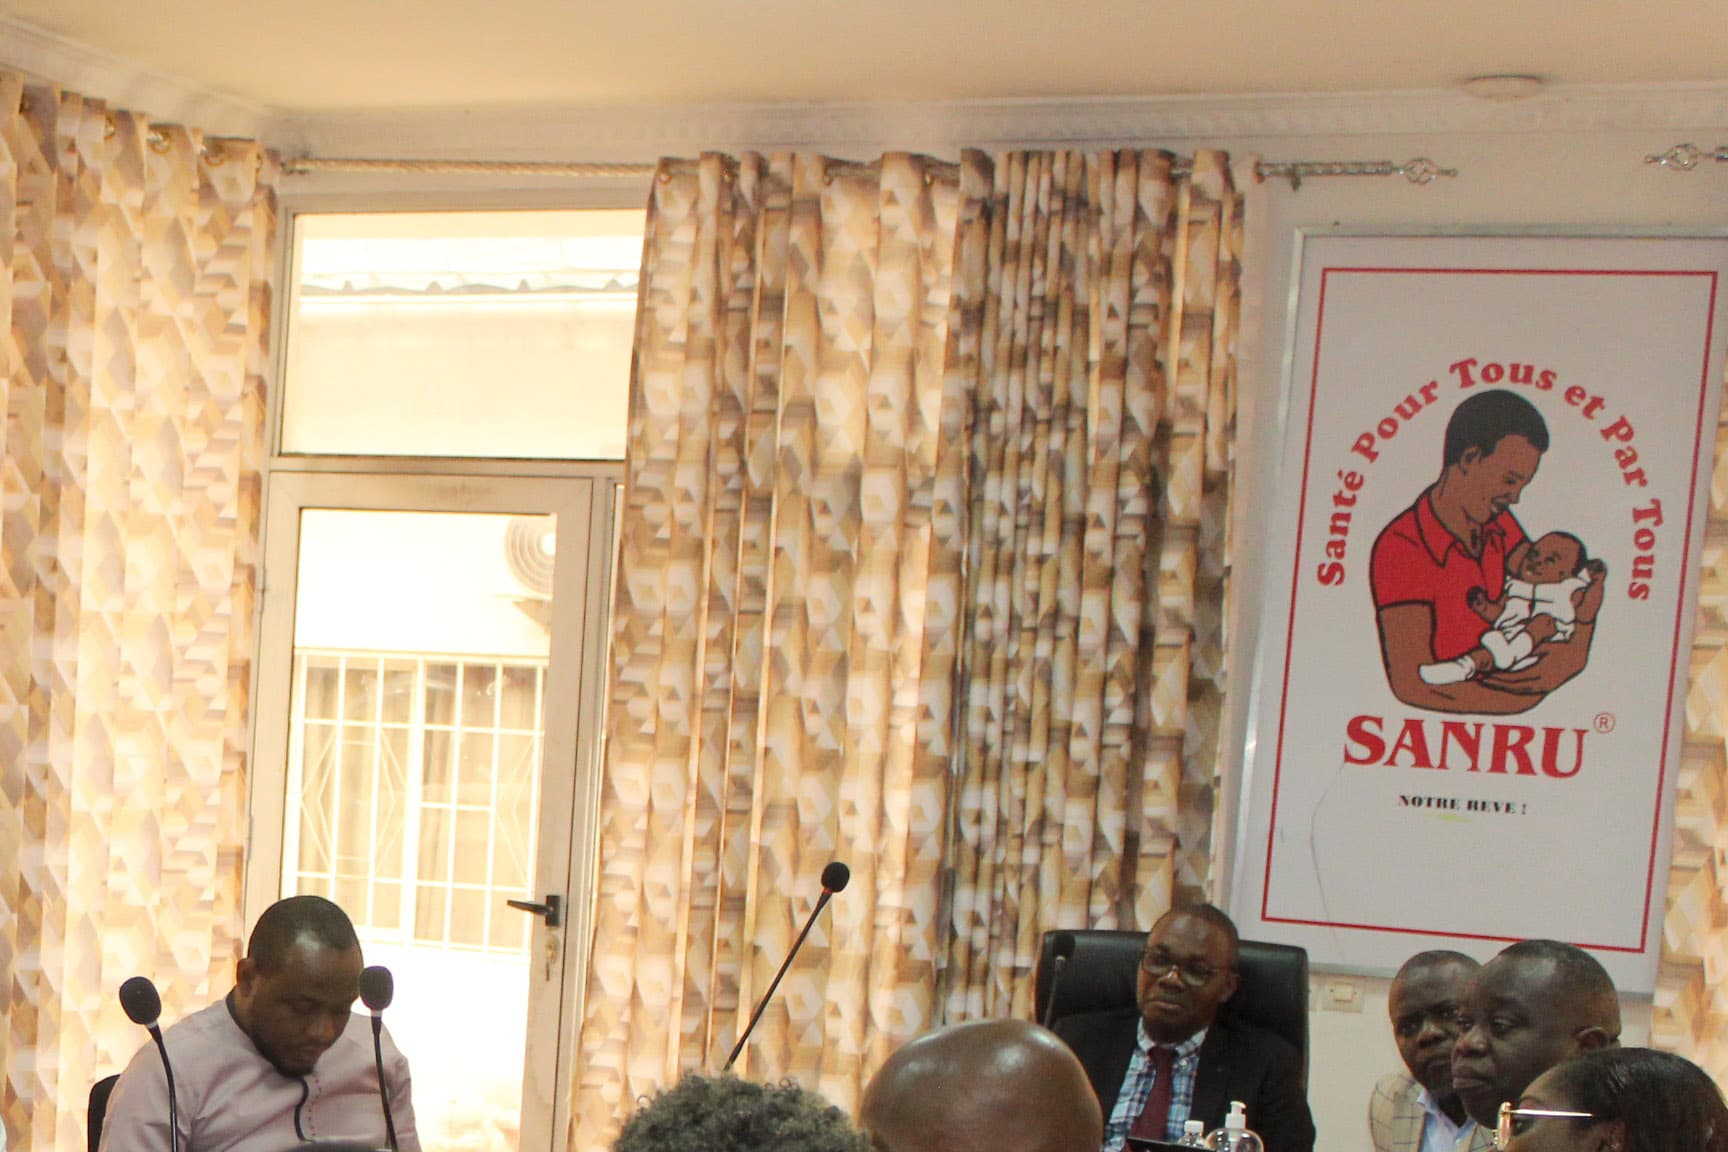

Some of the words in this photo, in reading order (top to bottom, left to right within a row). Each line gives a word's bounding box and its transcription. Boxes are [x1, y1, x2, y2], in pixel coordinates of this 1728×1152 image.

[1317, 469, 1365, 587] Santé
[1351, 381, 1439, 463] Pour
[1448, 357, 1557, 391] Tous
[1563, 385, 1606, 420] et
[1599, 415, 1648, 488] Par
[1628, 497, 1664, 602] Tous
[1343, 715, 1589, 780] SANRU
[1399, 794, 1460, 810] NOTRE
